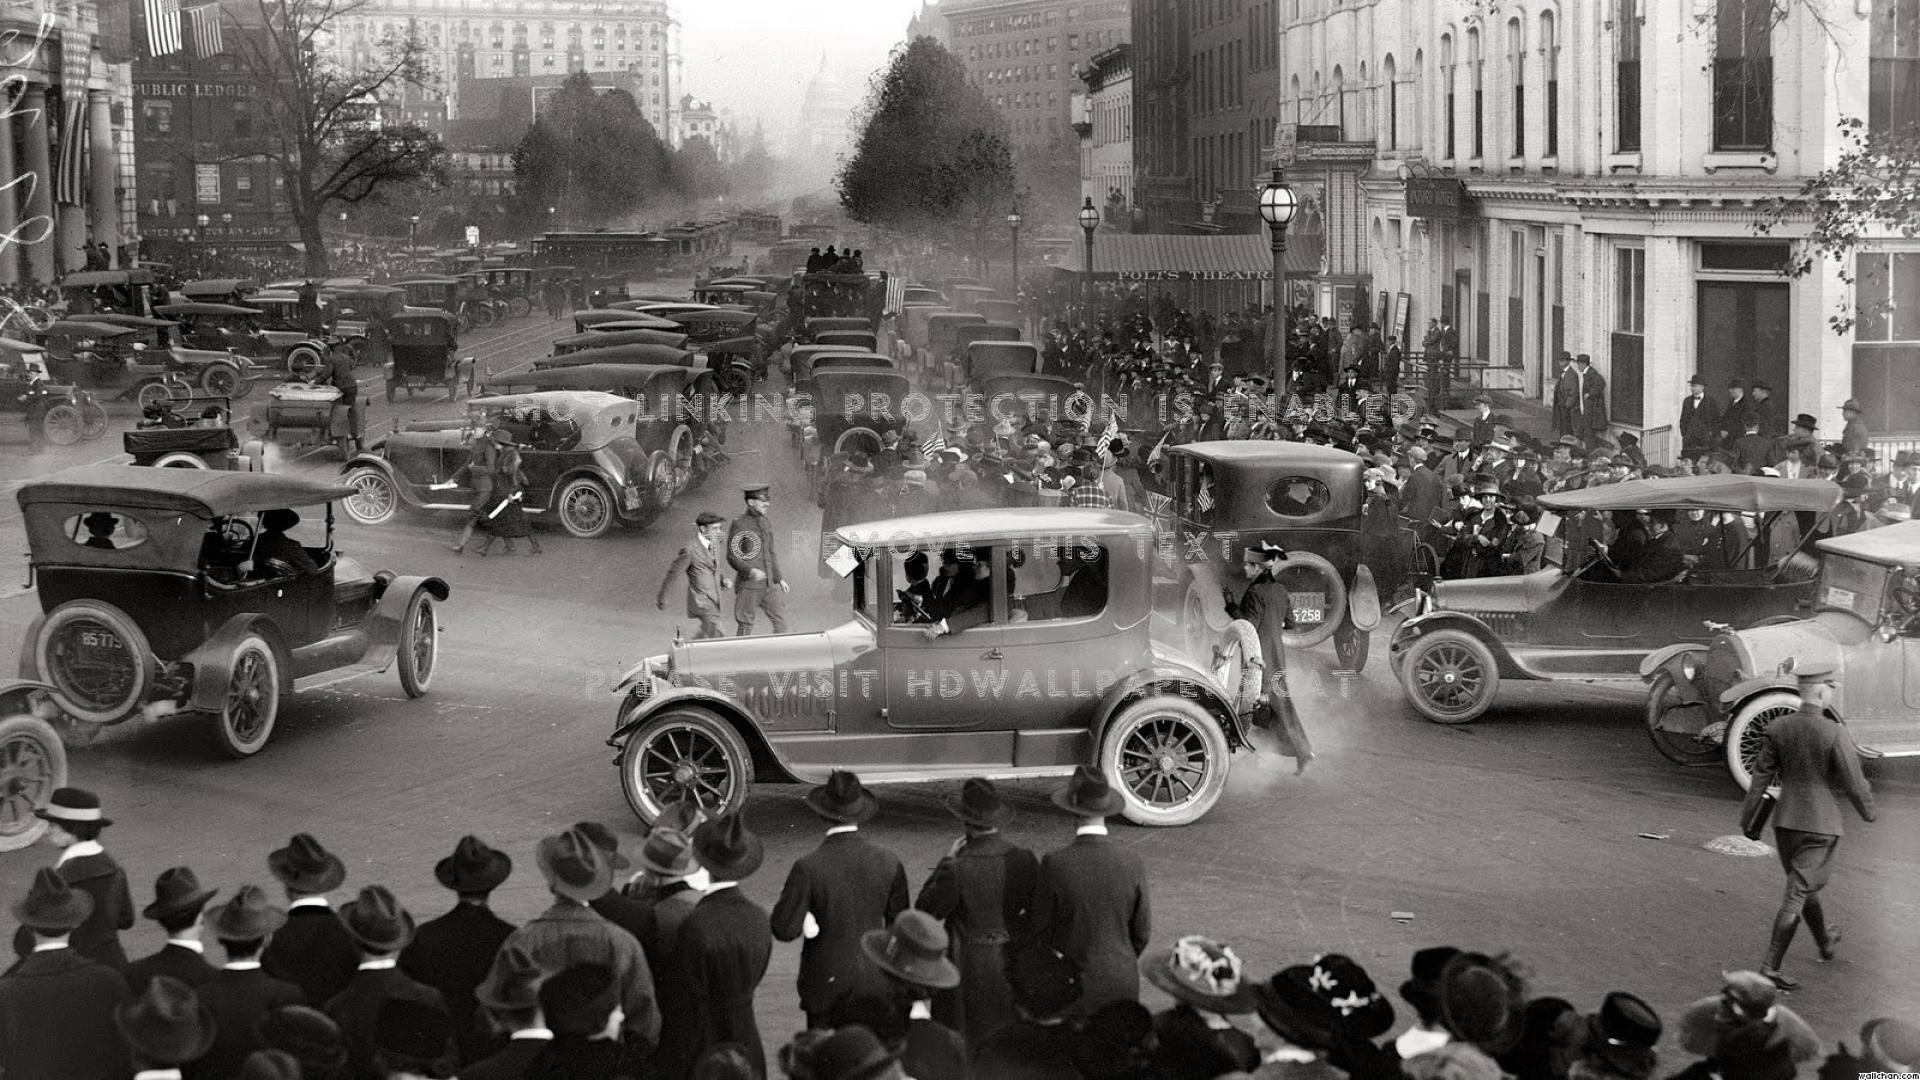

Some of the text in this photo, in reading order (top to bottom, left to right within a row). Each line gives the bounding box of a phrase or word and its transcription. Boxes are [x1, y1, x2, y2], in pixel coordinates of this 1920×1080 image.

[131, 84, 257, 97] PUBLIC LEDGER
[1117, 270, 1274, 280] POLI'S THEATR
